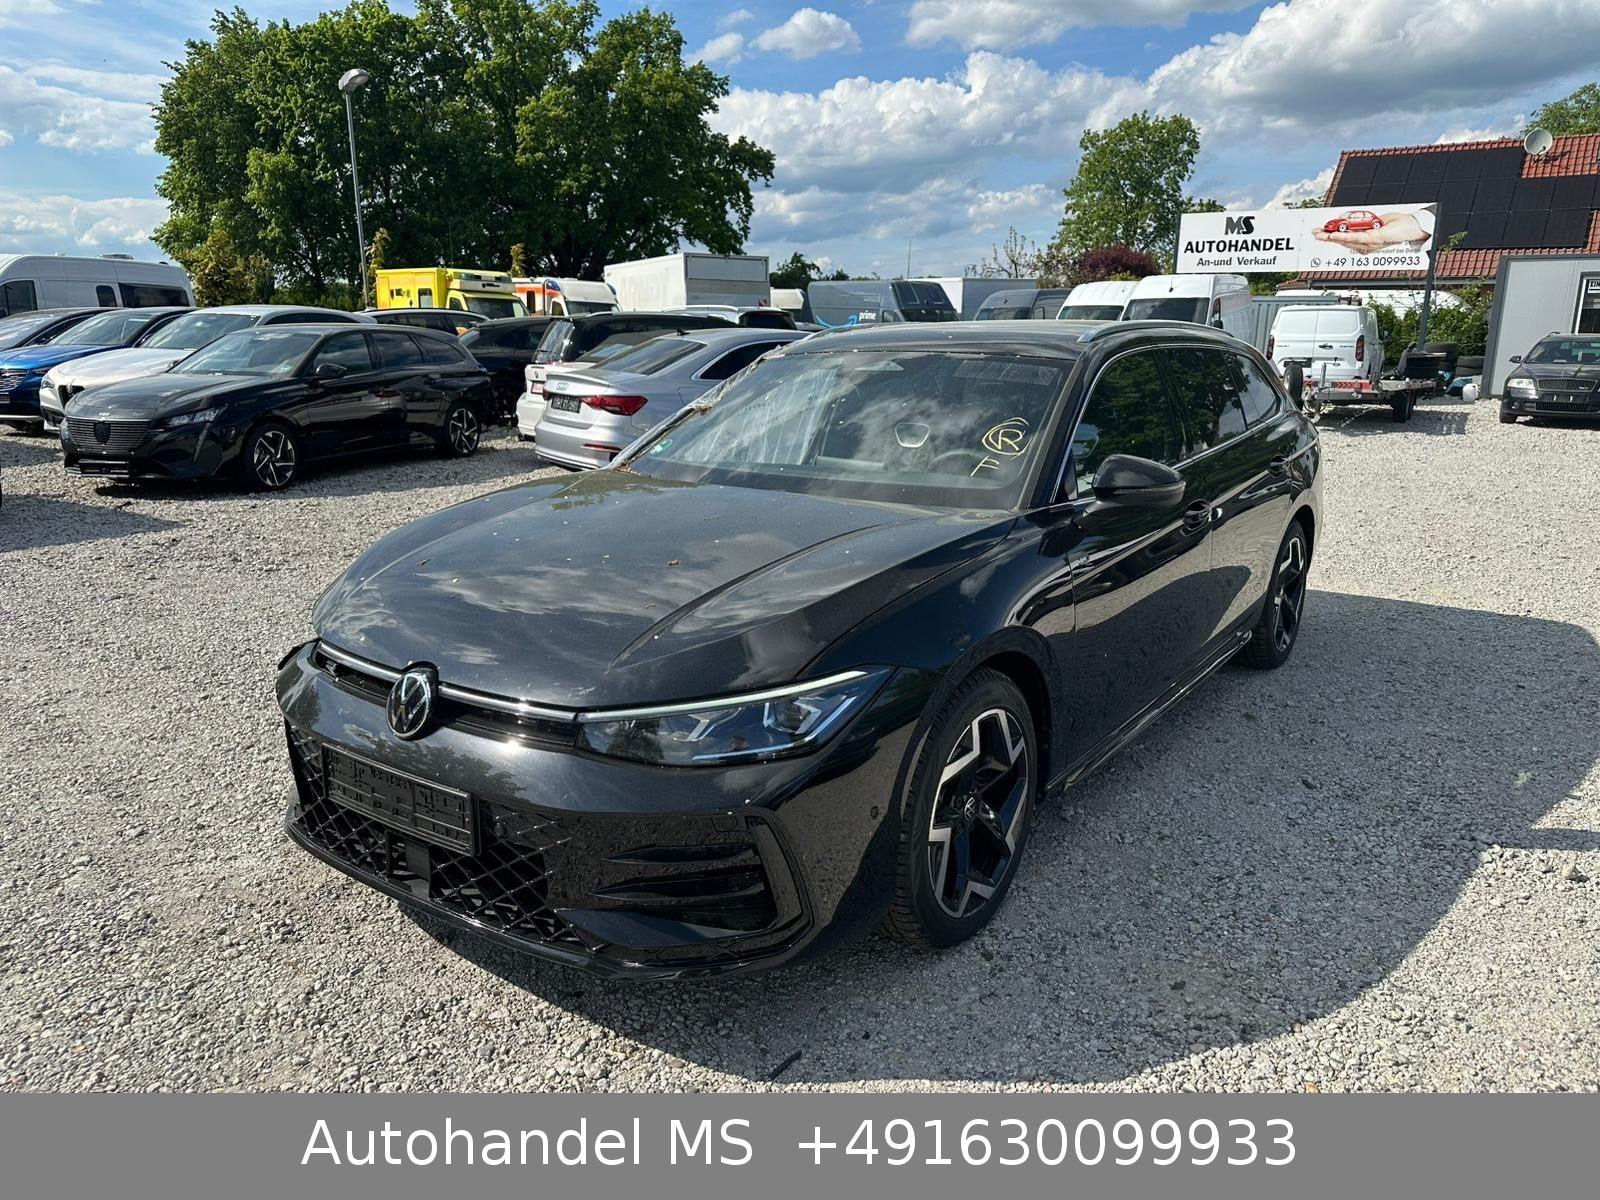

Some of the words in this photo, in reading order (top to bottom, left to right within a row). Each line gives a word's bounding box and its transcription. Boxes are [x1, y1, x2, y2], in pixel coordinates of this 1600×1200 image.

[1224, 215, 1255, 235] MS
[1183, 237, 1294, 254] AUTOHANDEL
[1196, 257, 1232, 267] An-und
[1236, 255, 1277, 266] Verkauf
[1325, 257, 1347, 267] +49
[1350, 257, 1370, 267] 163
[1372, 256, 1421, 267] 0099933
[858, 310, 877, 321] prime
